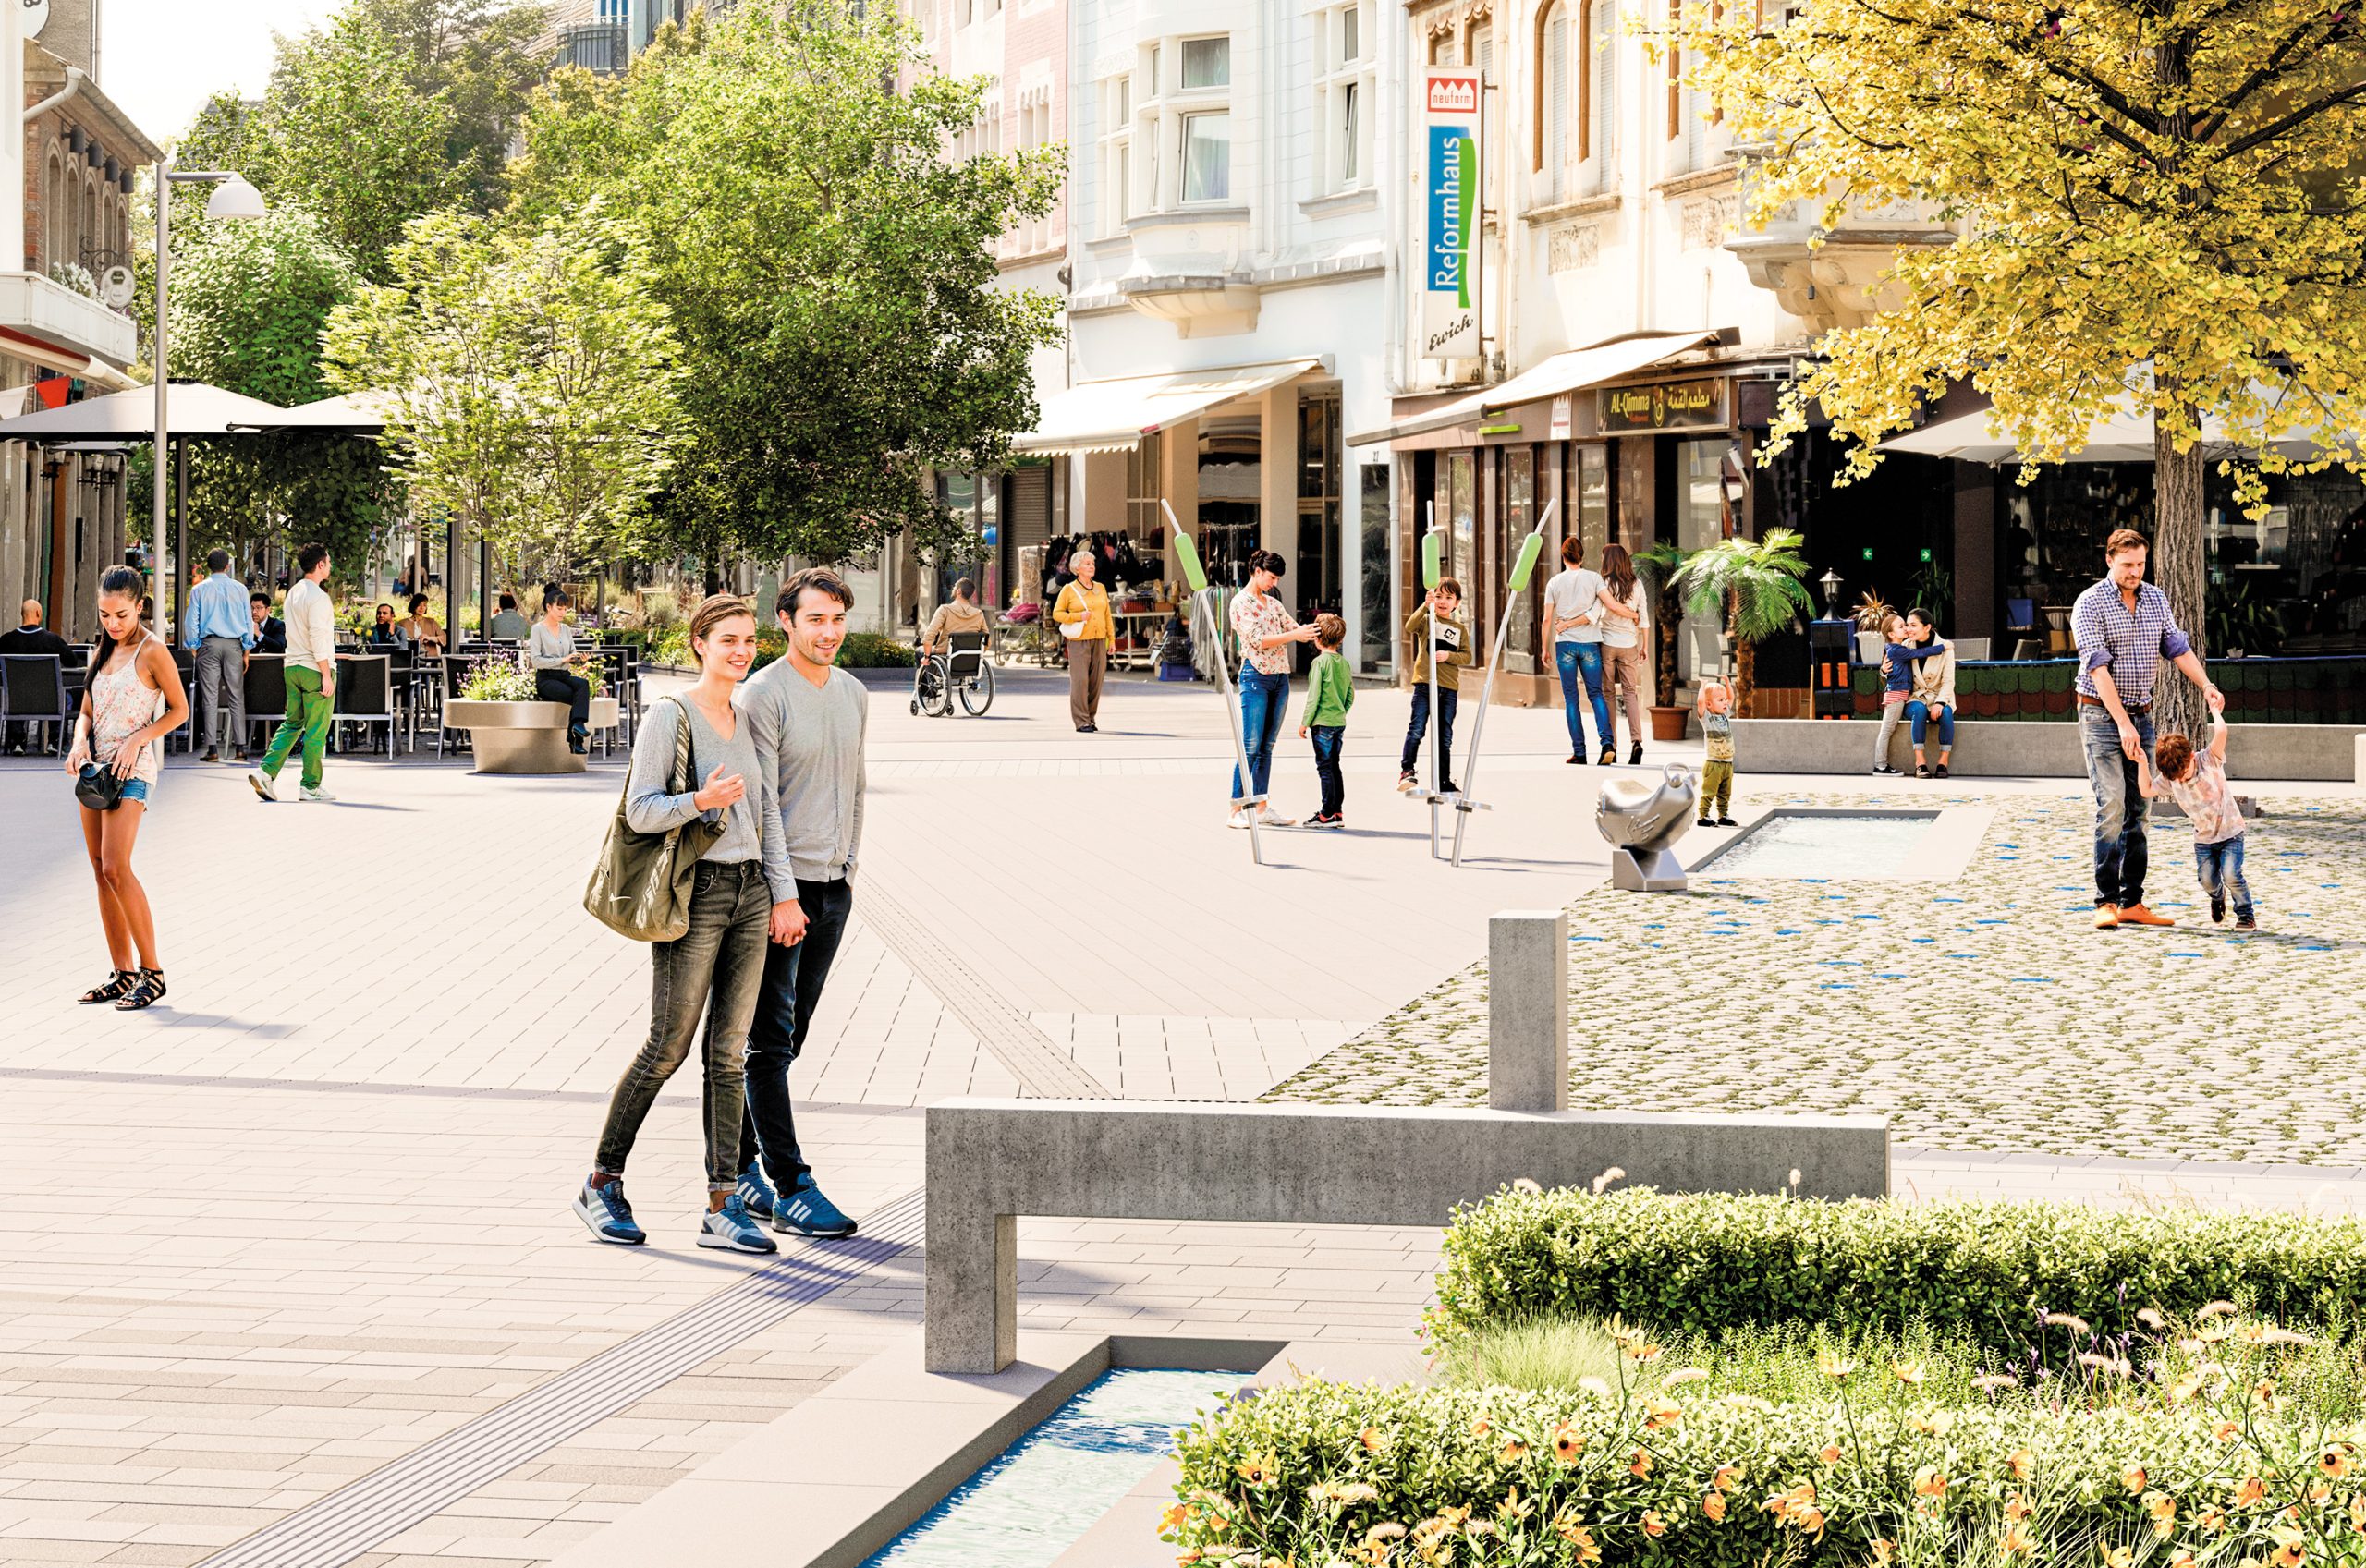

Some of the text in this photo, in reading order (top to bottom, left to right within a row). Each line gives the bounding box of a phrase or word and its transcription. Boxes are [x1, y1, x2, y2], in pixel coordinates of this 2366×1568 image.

[1433, 90, 1471, 104] neuform
[1434, 136, 1468, 287] Reformhaus
[1429, 314, 1474, 351] Ewich
